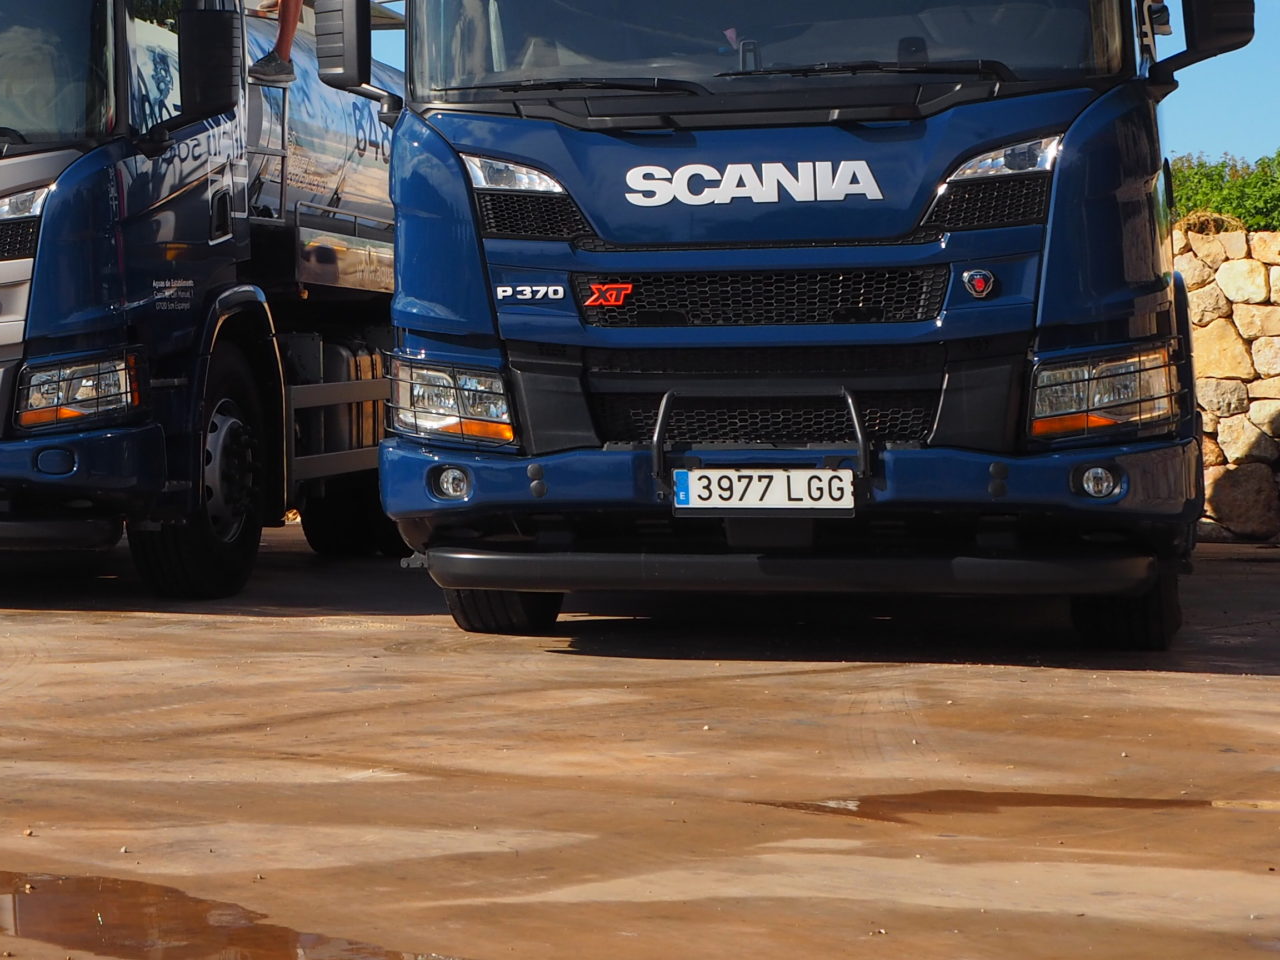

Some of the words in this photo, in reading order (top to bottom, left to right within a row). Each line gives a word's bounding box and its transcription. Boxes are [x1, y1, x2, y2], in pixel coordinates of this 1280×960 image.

[624, 159, 885, 207] SCANIA
[584, 283, 633, 306] XT
[679, 491, 686, 500] E
[697, 474, 774, 502] 3977
[786, 474, 845, 502] LGG
